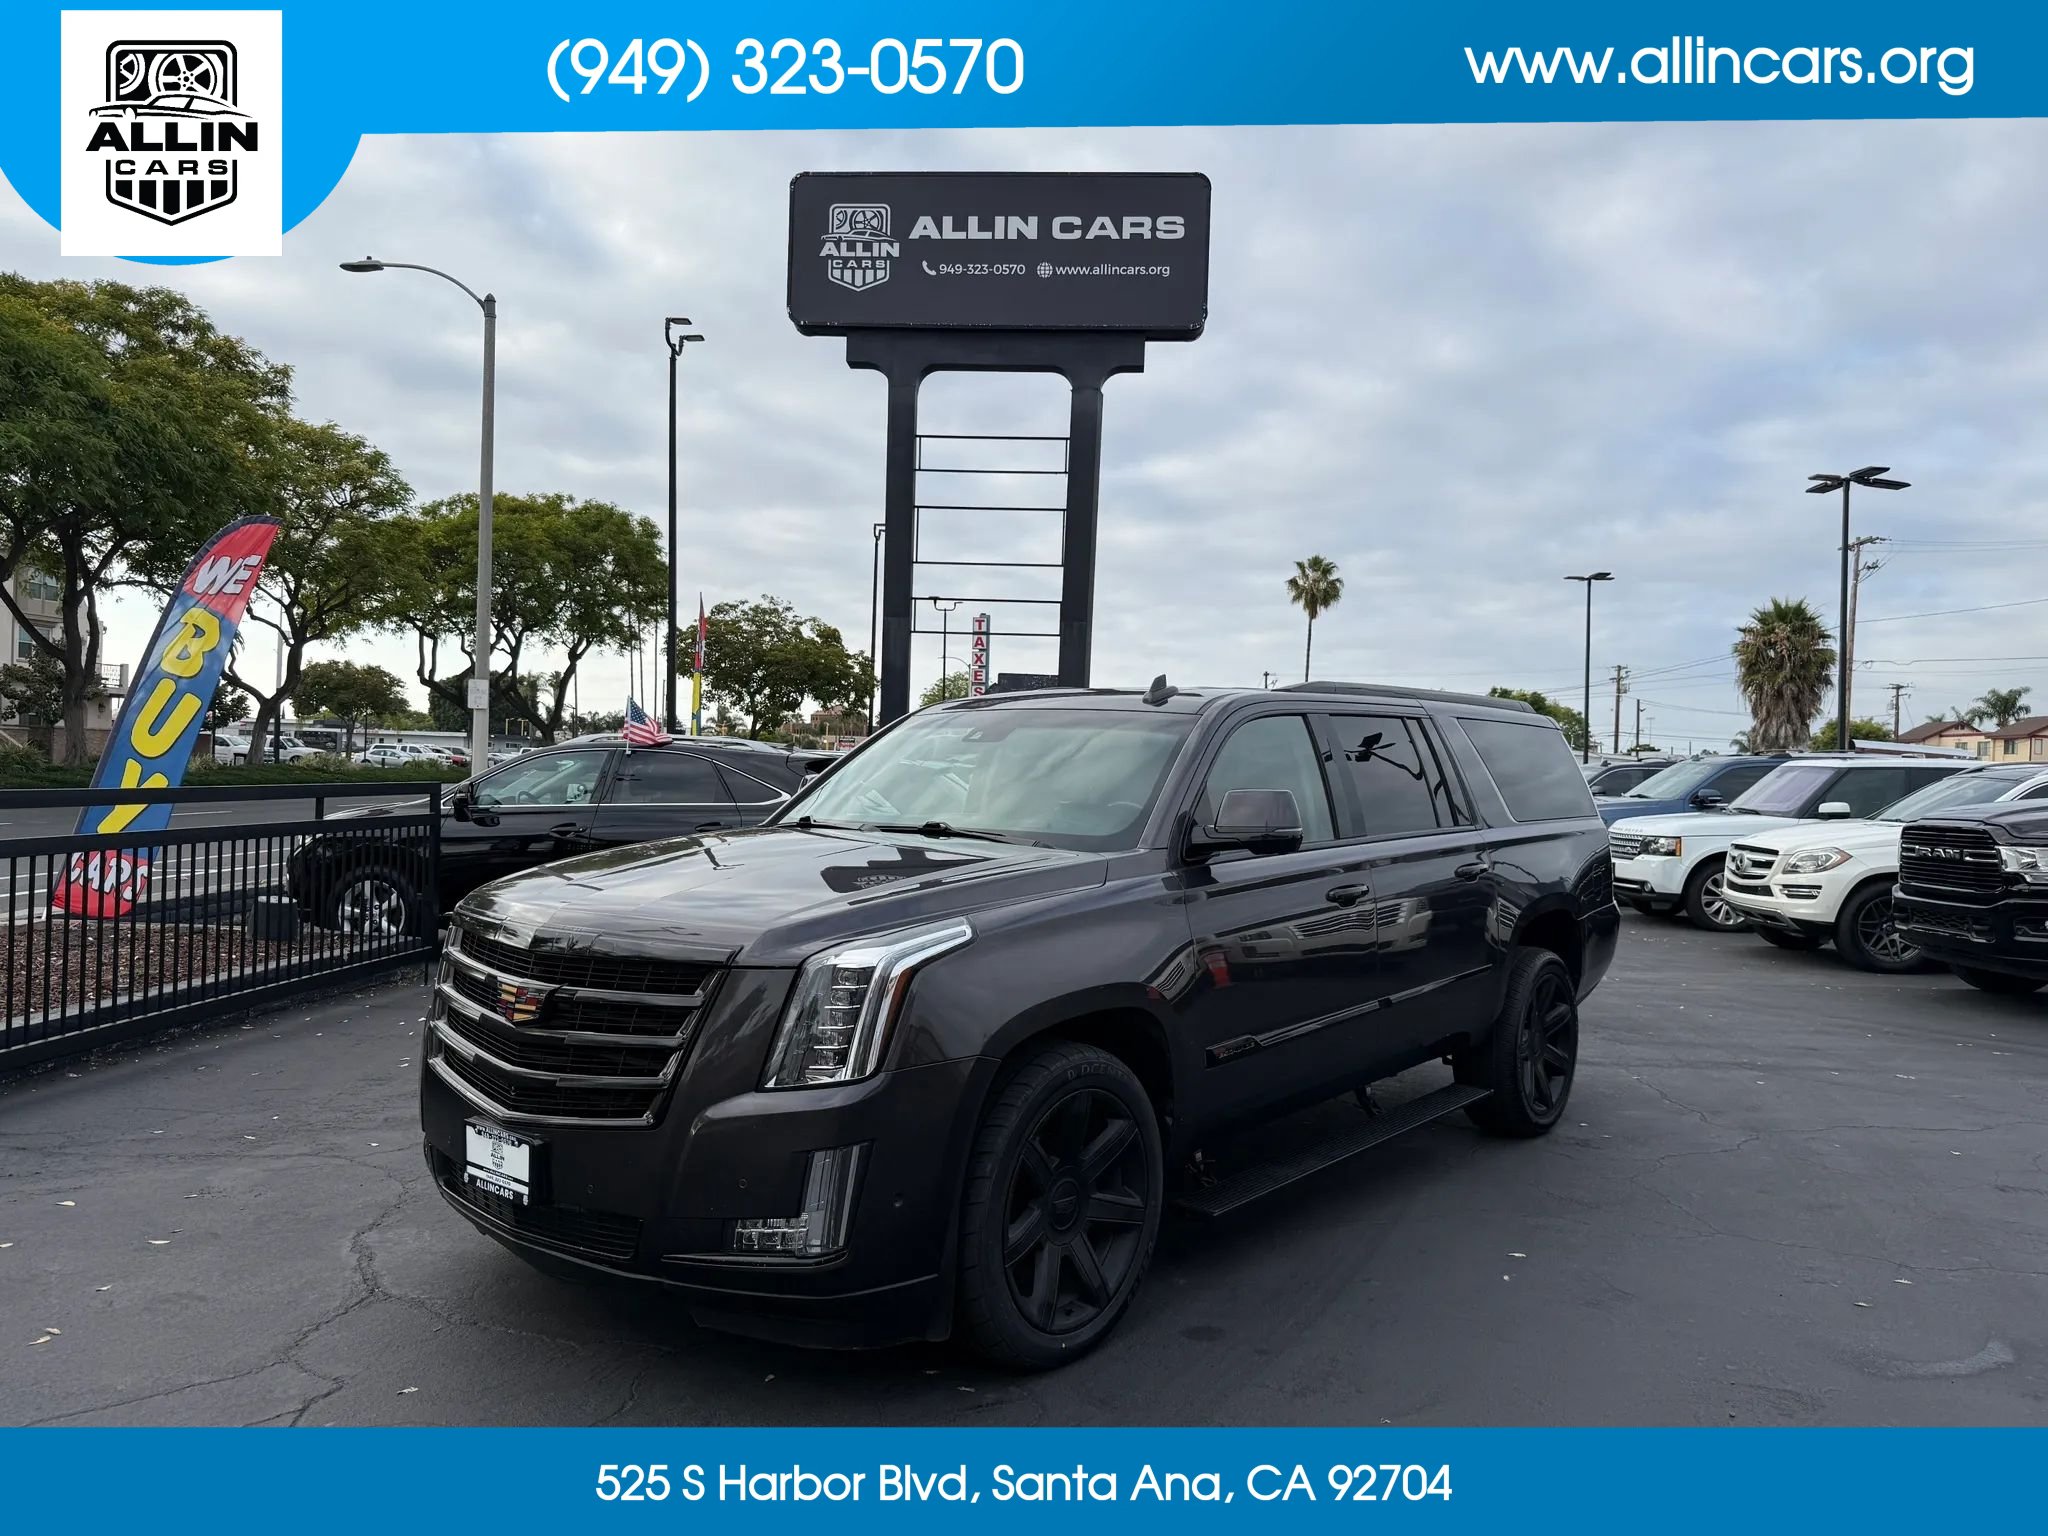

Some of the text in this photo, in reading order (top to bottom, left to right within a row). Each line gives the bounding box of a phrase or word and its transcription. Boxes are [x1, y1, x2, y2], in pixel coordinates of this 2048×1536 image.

[909, 216, 1184, 239] ALLIN CARS
[819, 242, 899, 257] ALLIN
[832, 260, 885, 269] CARS
[939, 264, 1026, 275] 949-323-0570
[1055, 264, 1170, 278] www.allincars.org
[194, 555, 262, 596] WE
[973, 619, 985, 696] TAXES
[97, 606, 221, 833] BUY
[1915, 846, 1961, 860] RAM
[476, 1179, 514, 1200] ALLINCARS
